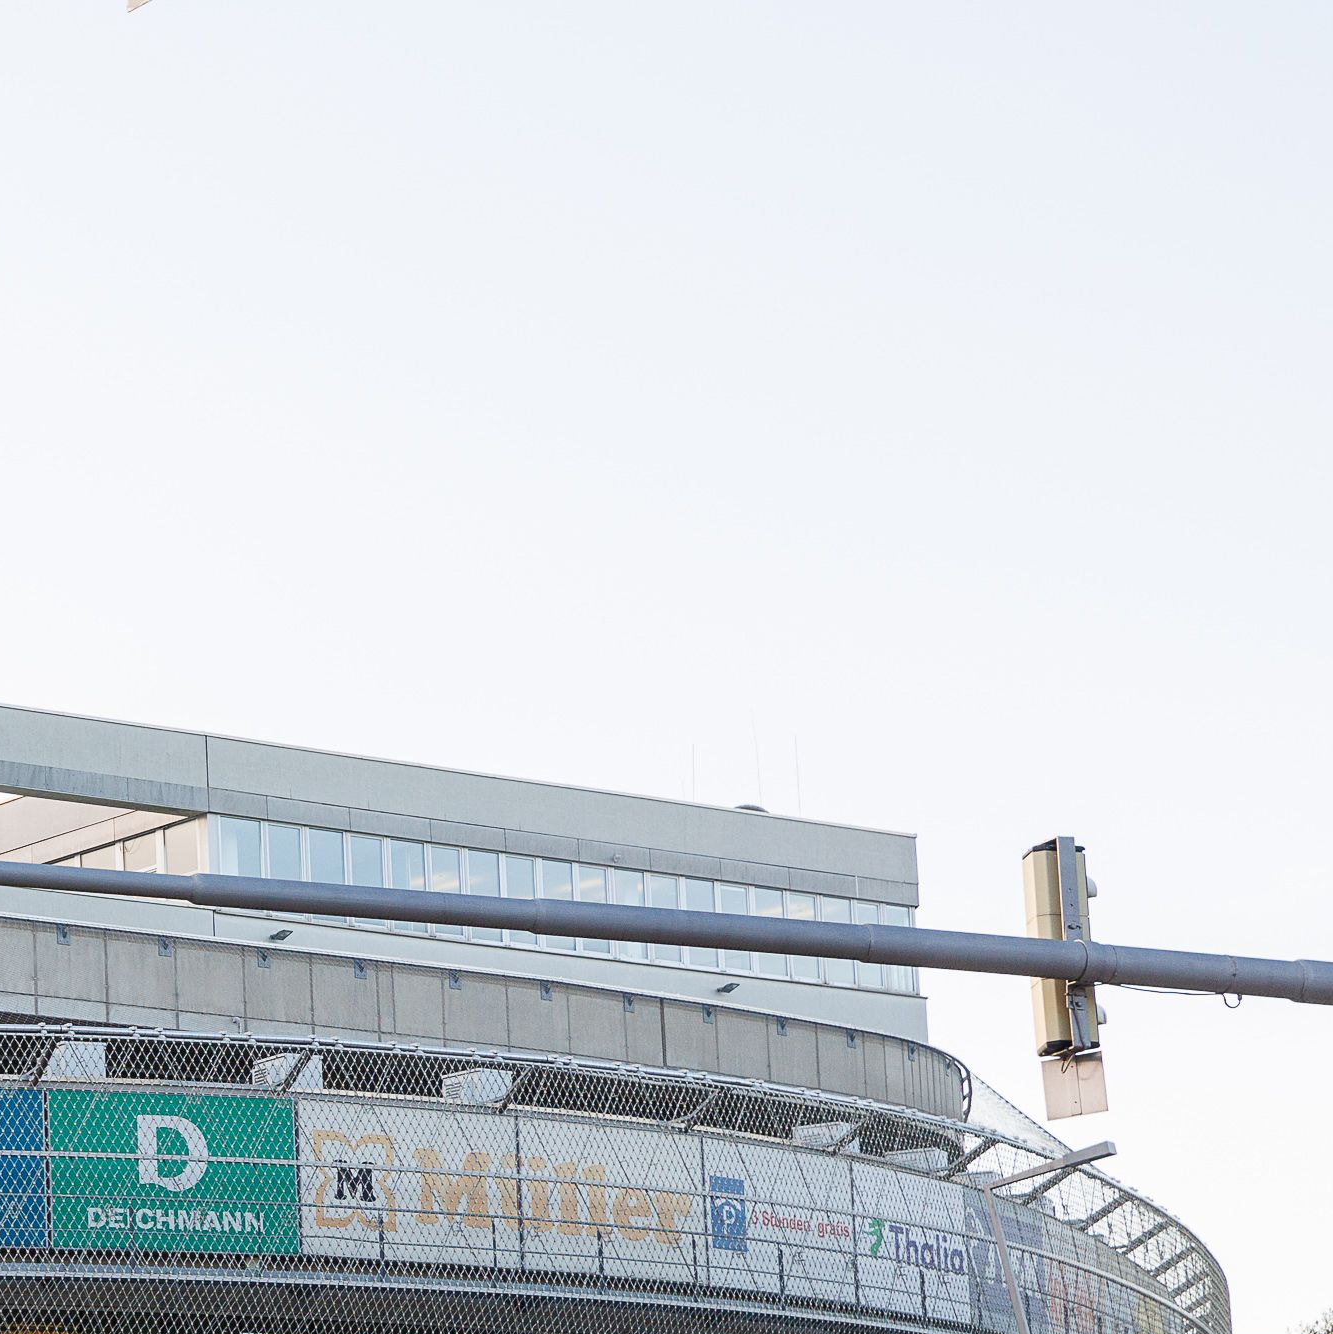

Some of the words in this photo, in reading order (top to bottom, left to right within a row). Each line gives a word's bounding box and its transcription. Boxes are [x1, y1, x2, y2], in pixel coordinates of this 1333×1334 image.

[137, 1114, 209, 1192] D
[86, 1206, 265, 1235] DEICHMANN
[413, 1147, 694, 1246] Müller
[751, 1210, 759, 1225] 3
[762, 1211, 811, 1233] Stunden
[817, 1219, 850, 1238] gratis
[889, 1224, 966, 1275] Thalia
